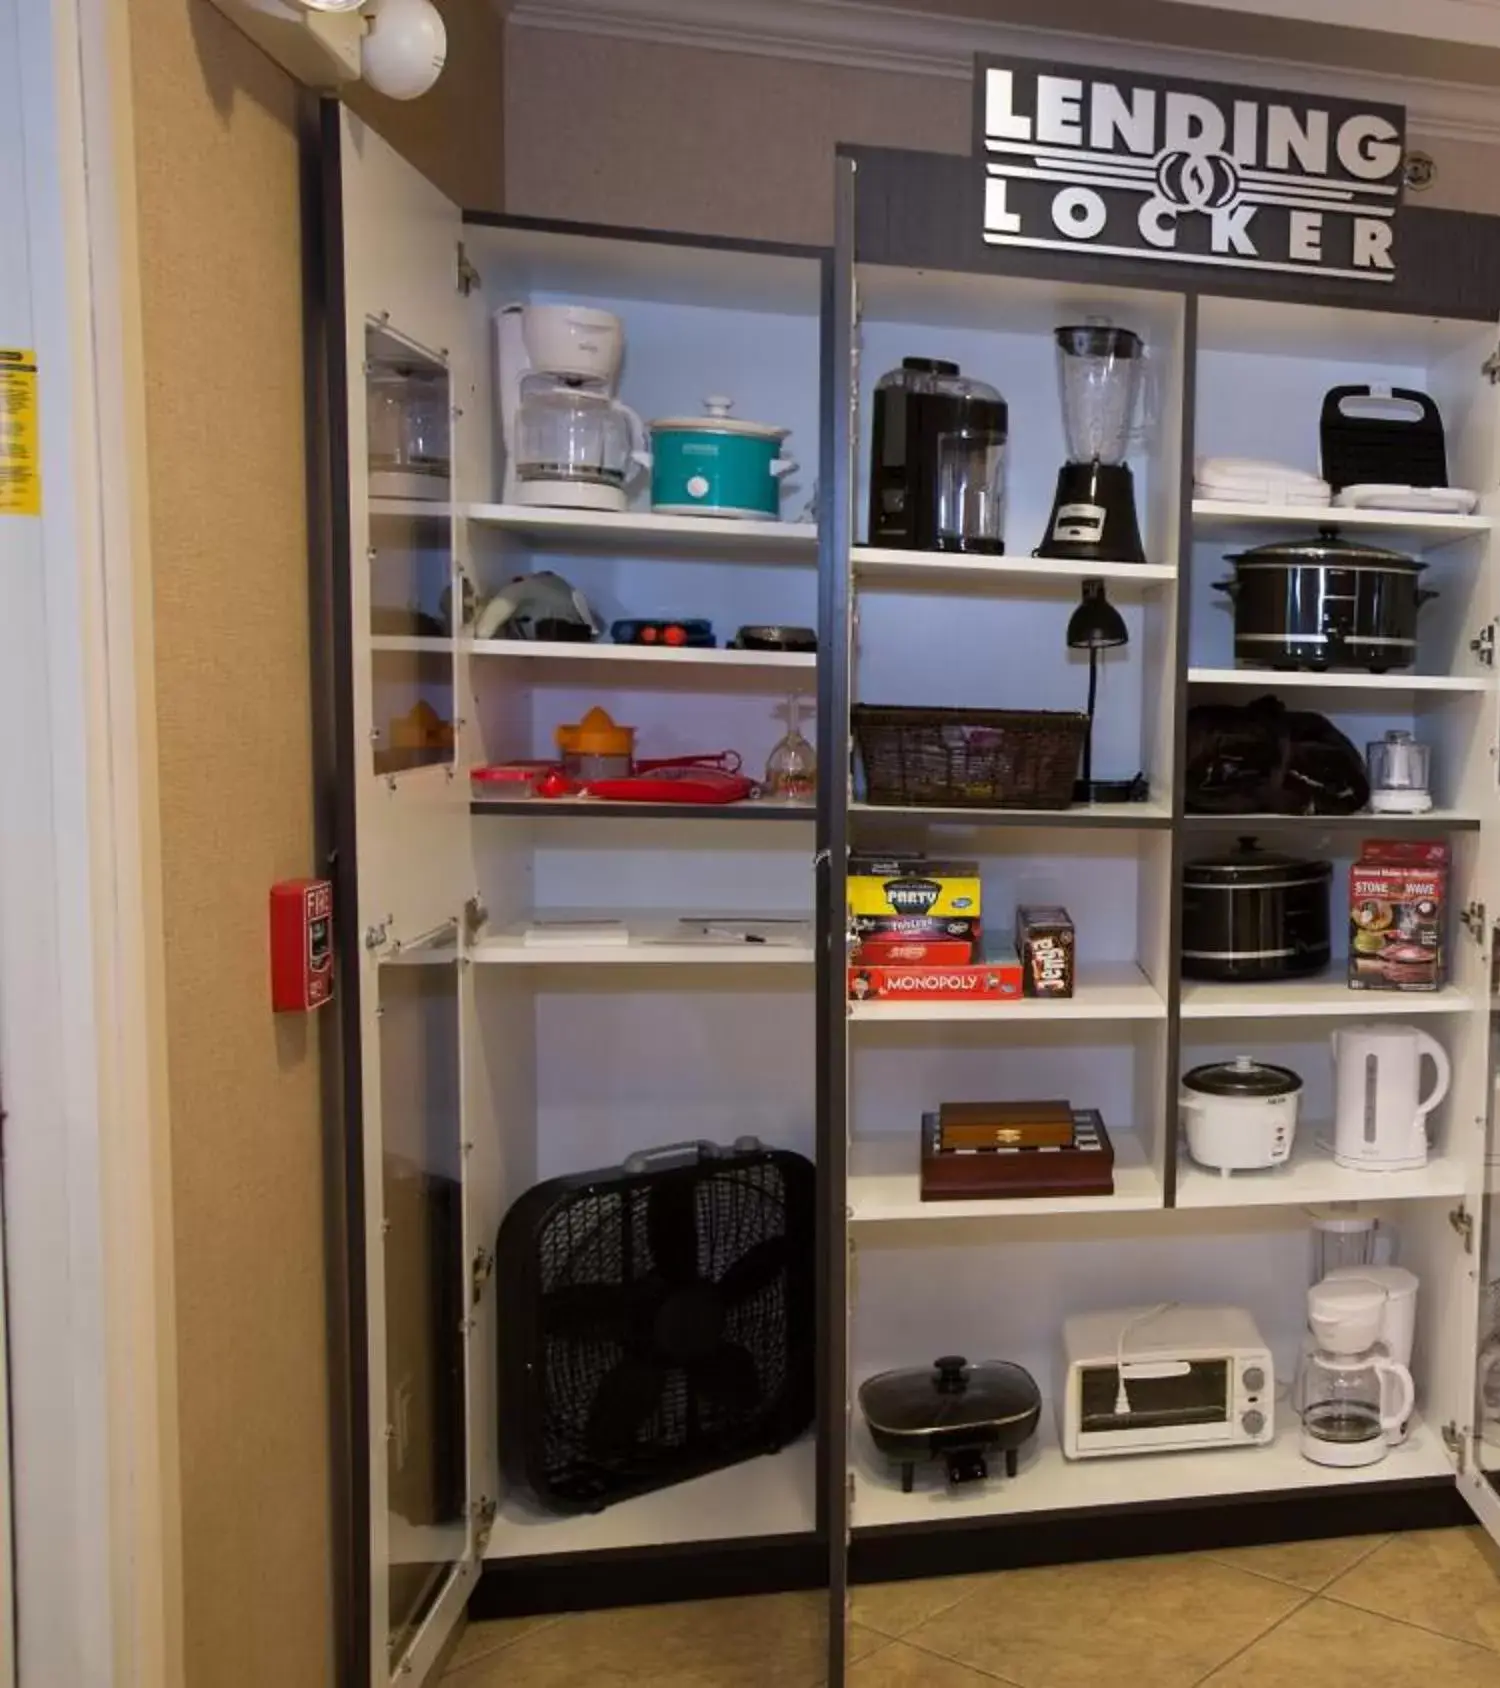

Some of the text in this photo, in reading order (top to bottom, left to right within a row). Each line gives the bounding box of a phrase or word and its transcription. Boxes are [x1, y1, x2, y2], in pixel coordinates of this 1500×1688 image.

[985, 68, 1401, 179] LENDING
[984, 177, 1395, 269] LOCKER
[888, 890, 937, 904] PARTY
[1354, 881, 1435, 894] STONE WAVE
[1032, 938, 1064, 990] Jenga
[887, 974, 977, 990] MONOPOLY
